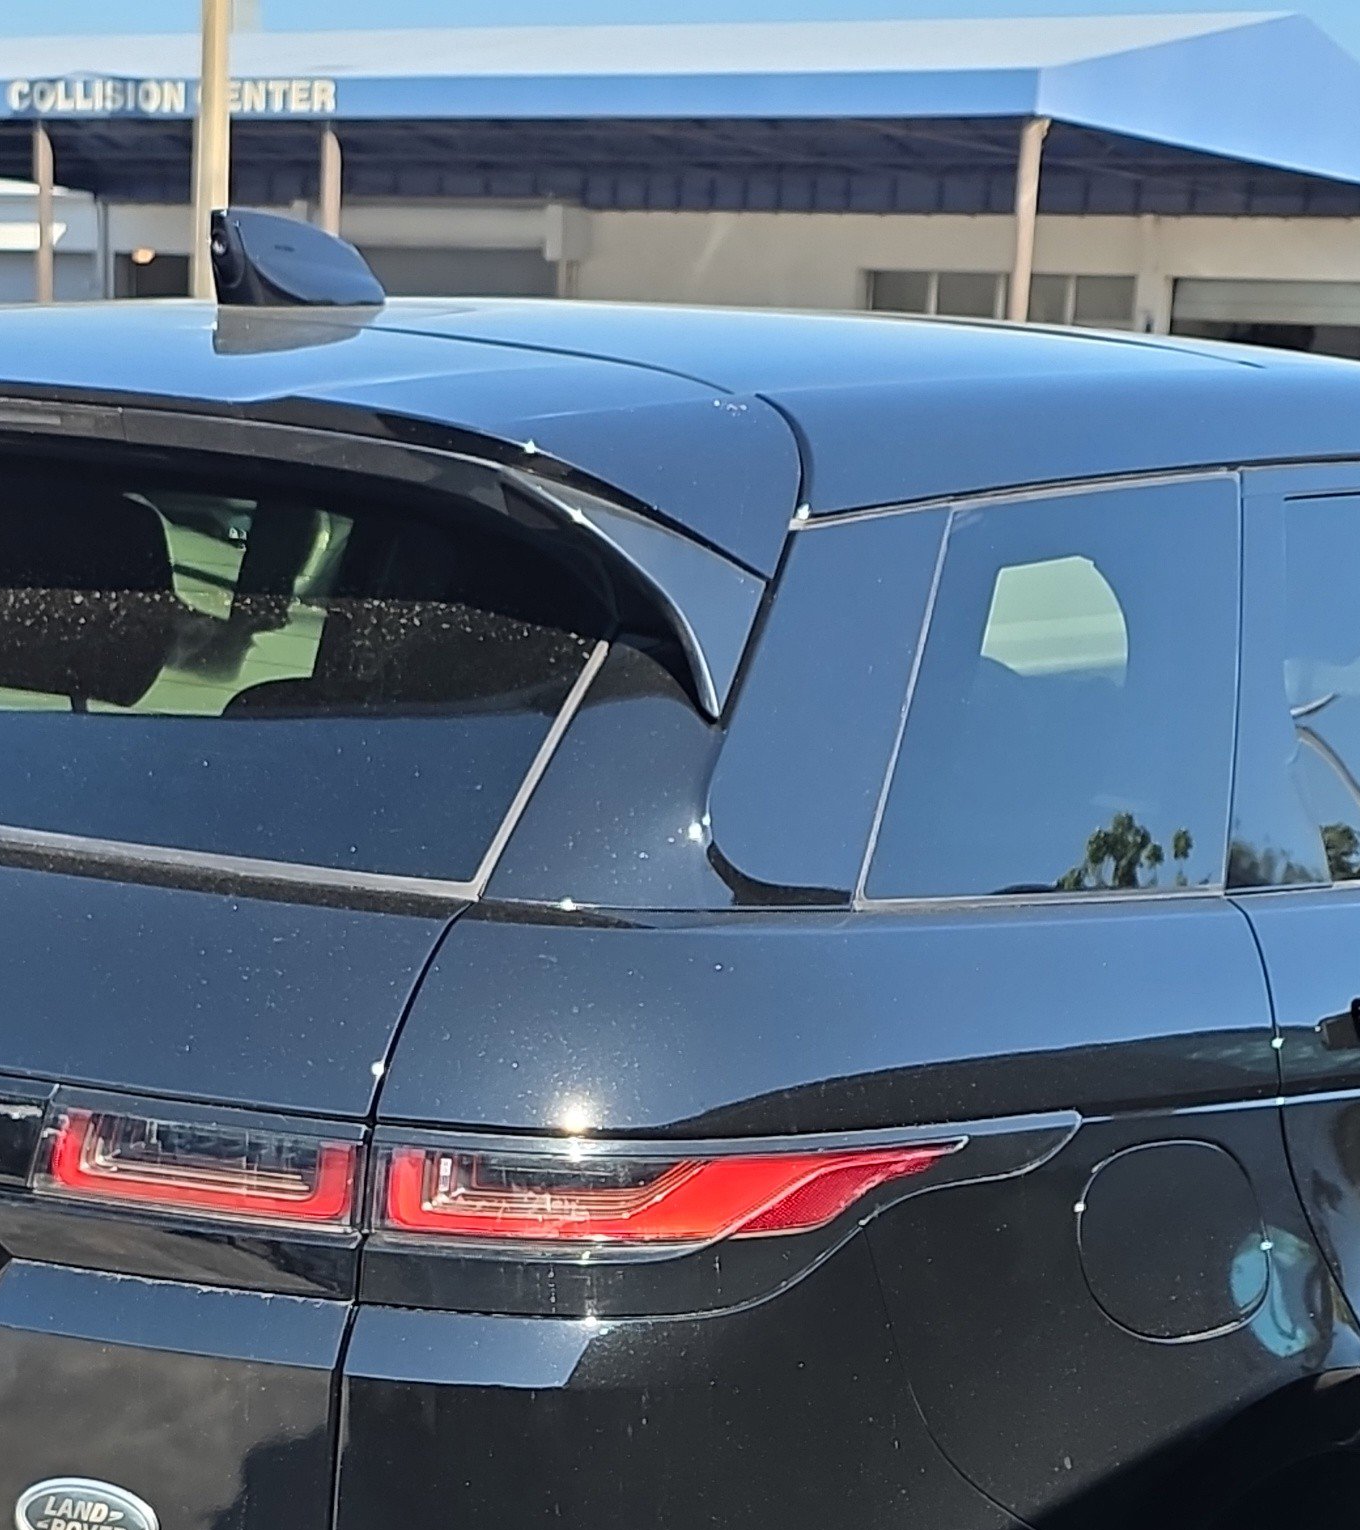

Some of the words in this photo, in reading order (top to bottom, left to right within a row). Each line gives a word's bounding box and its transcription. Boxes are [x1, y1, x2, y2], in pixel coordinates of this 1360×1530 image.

[7, 78, 185, 112] COLLISION
[197, 79, 337, 113] ENTER
[44, 1495, 109, 1523] LAND
